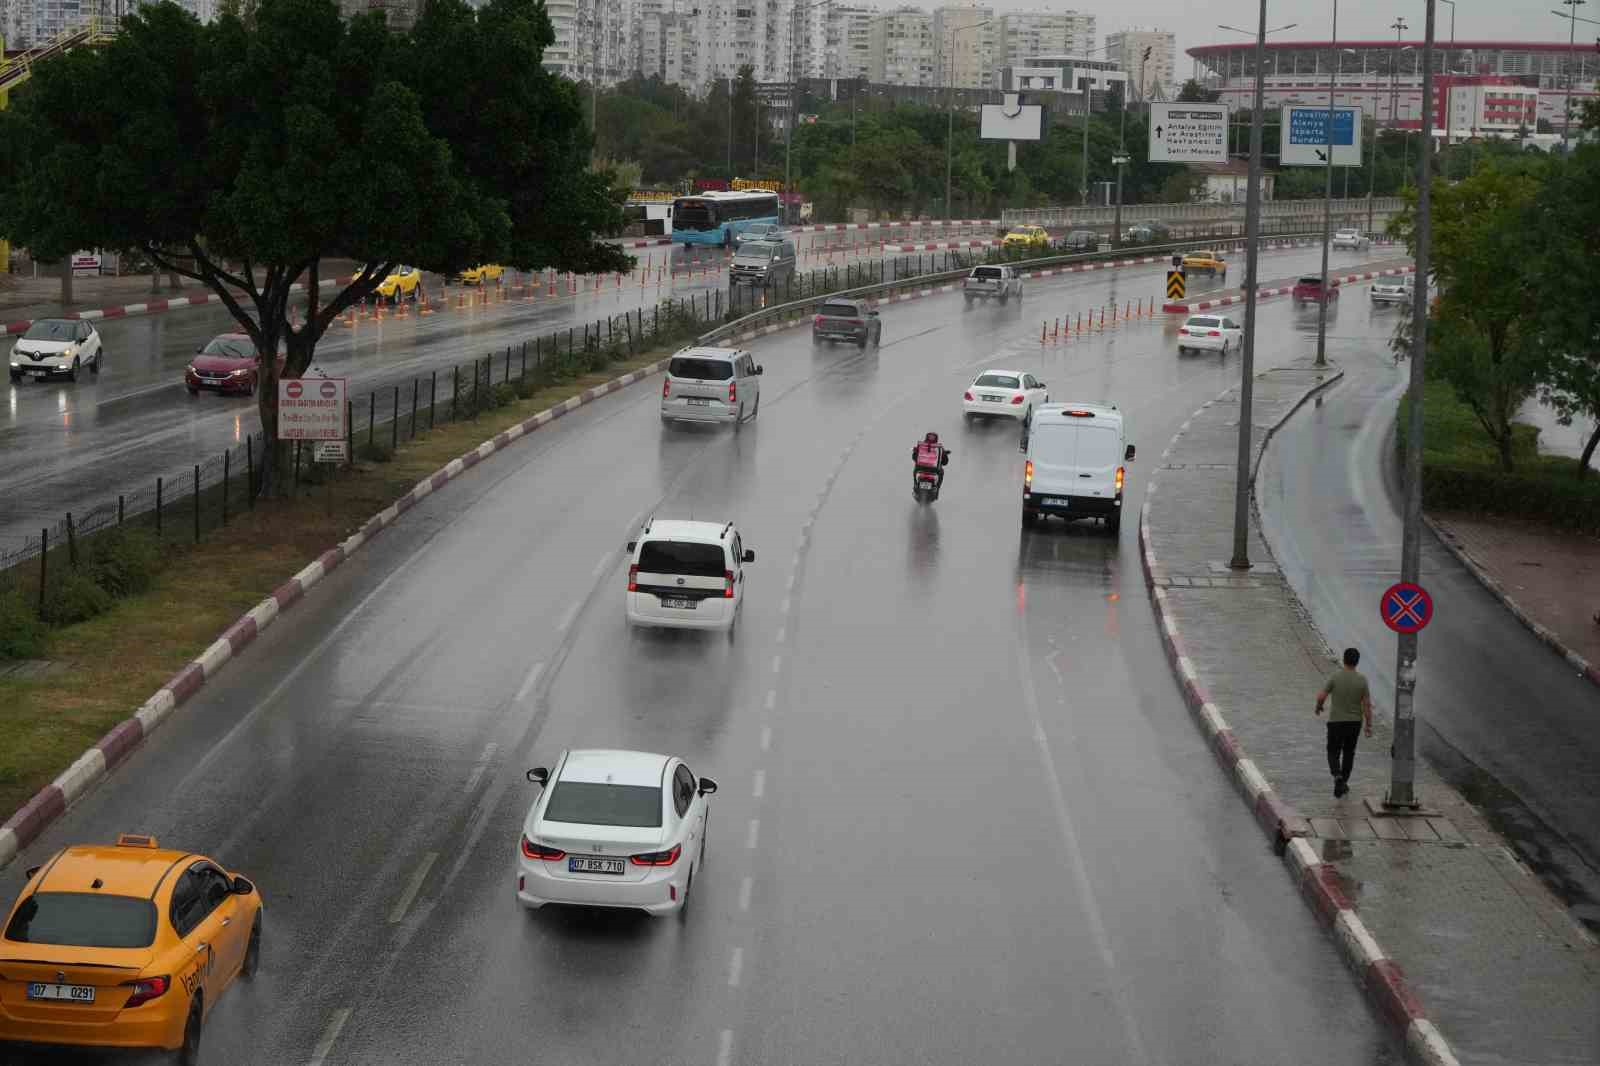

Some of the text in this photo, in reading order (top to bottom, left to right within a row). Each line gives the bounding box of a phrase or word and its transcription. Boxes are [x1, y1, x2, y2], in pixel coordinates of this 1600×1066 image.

[1291, 119, 1324, 128] Alanya
[576, 859, 585, 869] 07
[606, 862, 623, 871] 710
[34, 983, 94, 1000] 07 T 0291
